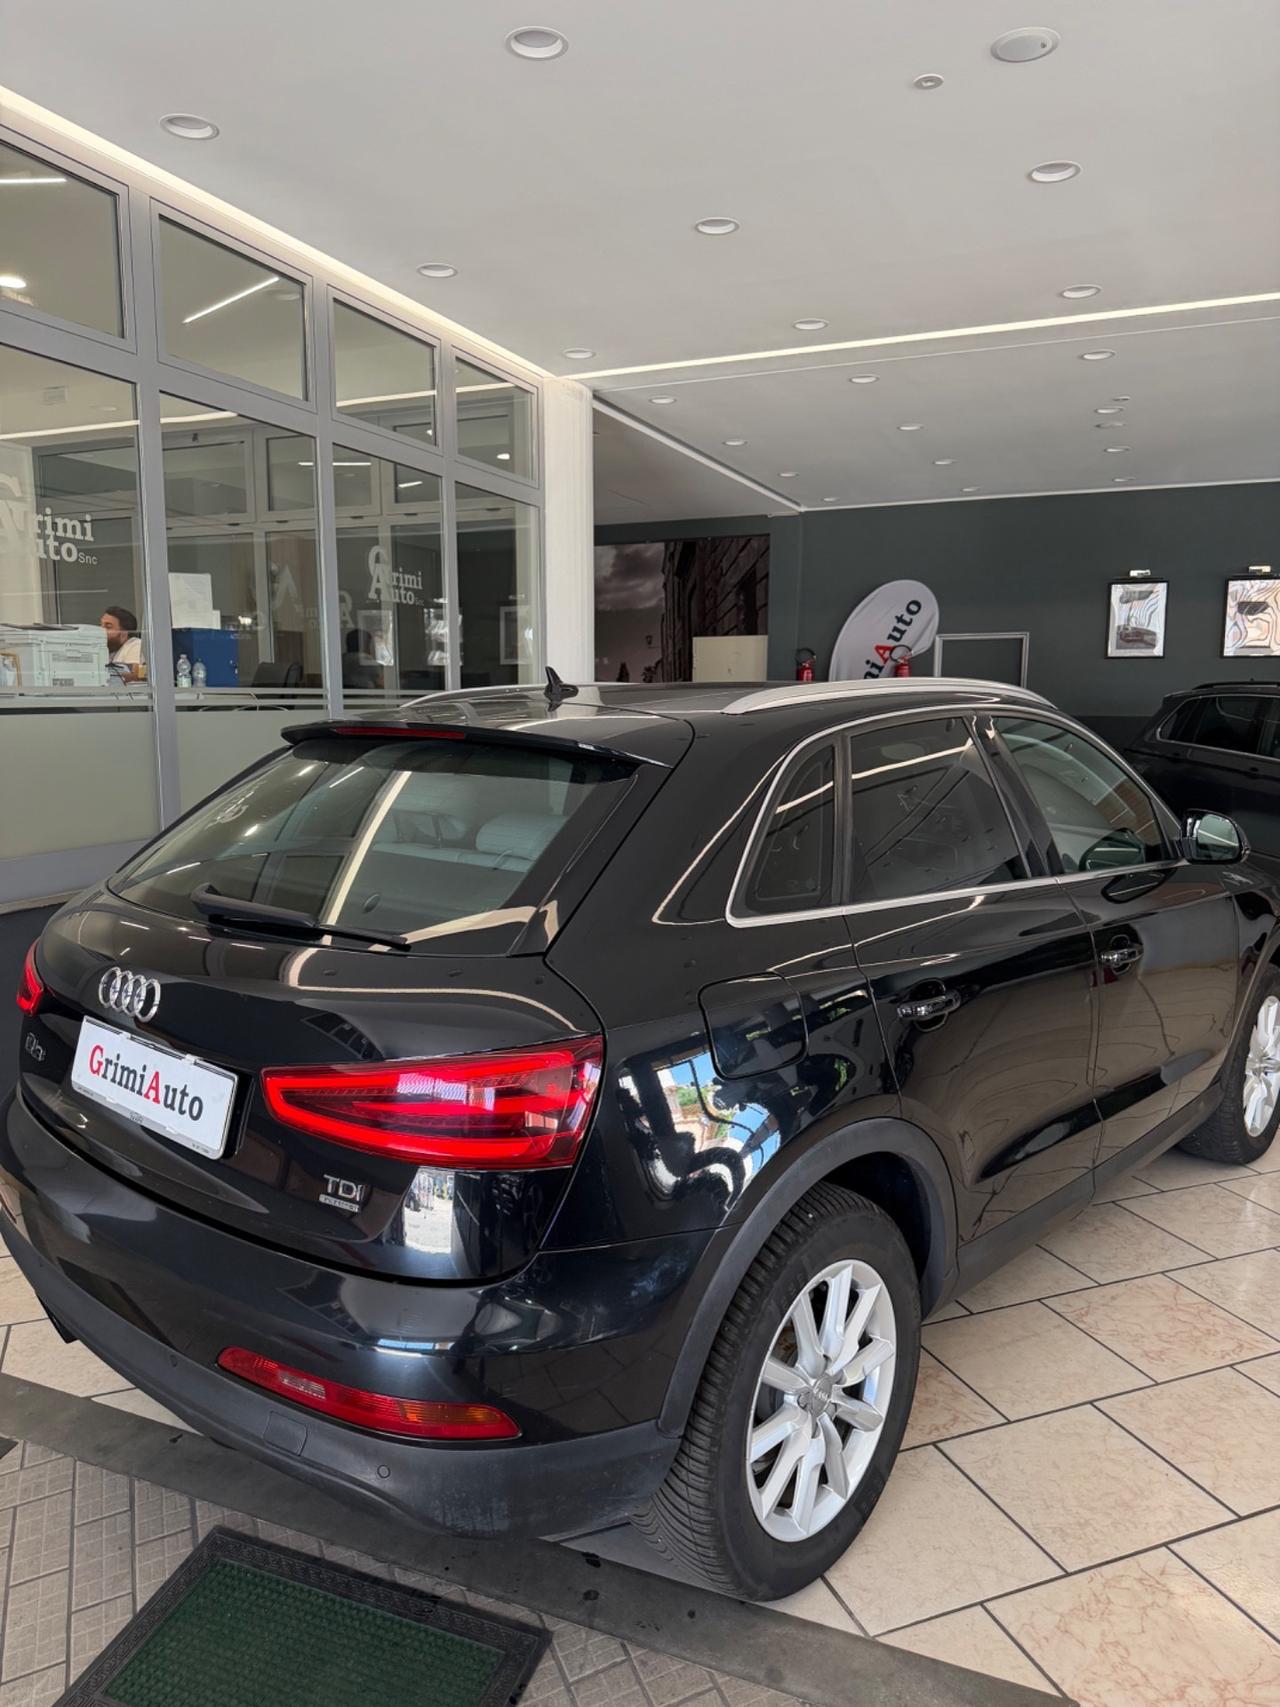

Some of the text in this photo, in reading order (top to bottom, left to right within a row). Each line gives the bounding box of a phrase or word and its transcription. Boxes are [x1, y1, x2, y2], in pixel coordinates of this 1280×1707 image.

[78, 551, 98, 565] Snc
[367, 563, 415, 605] Auto
[89, 1044, 204, 1122] GrimiAuto
